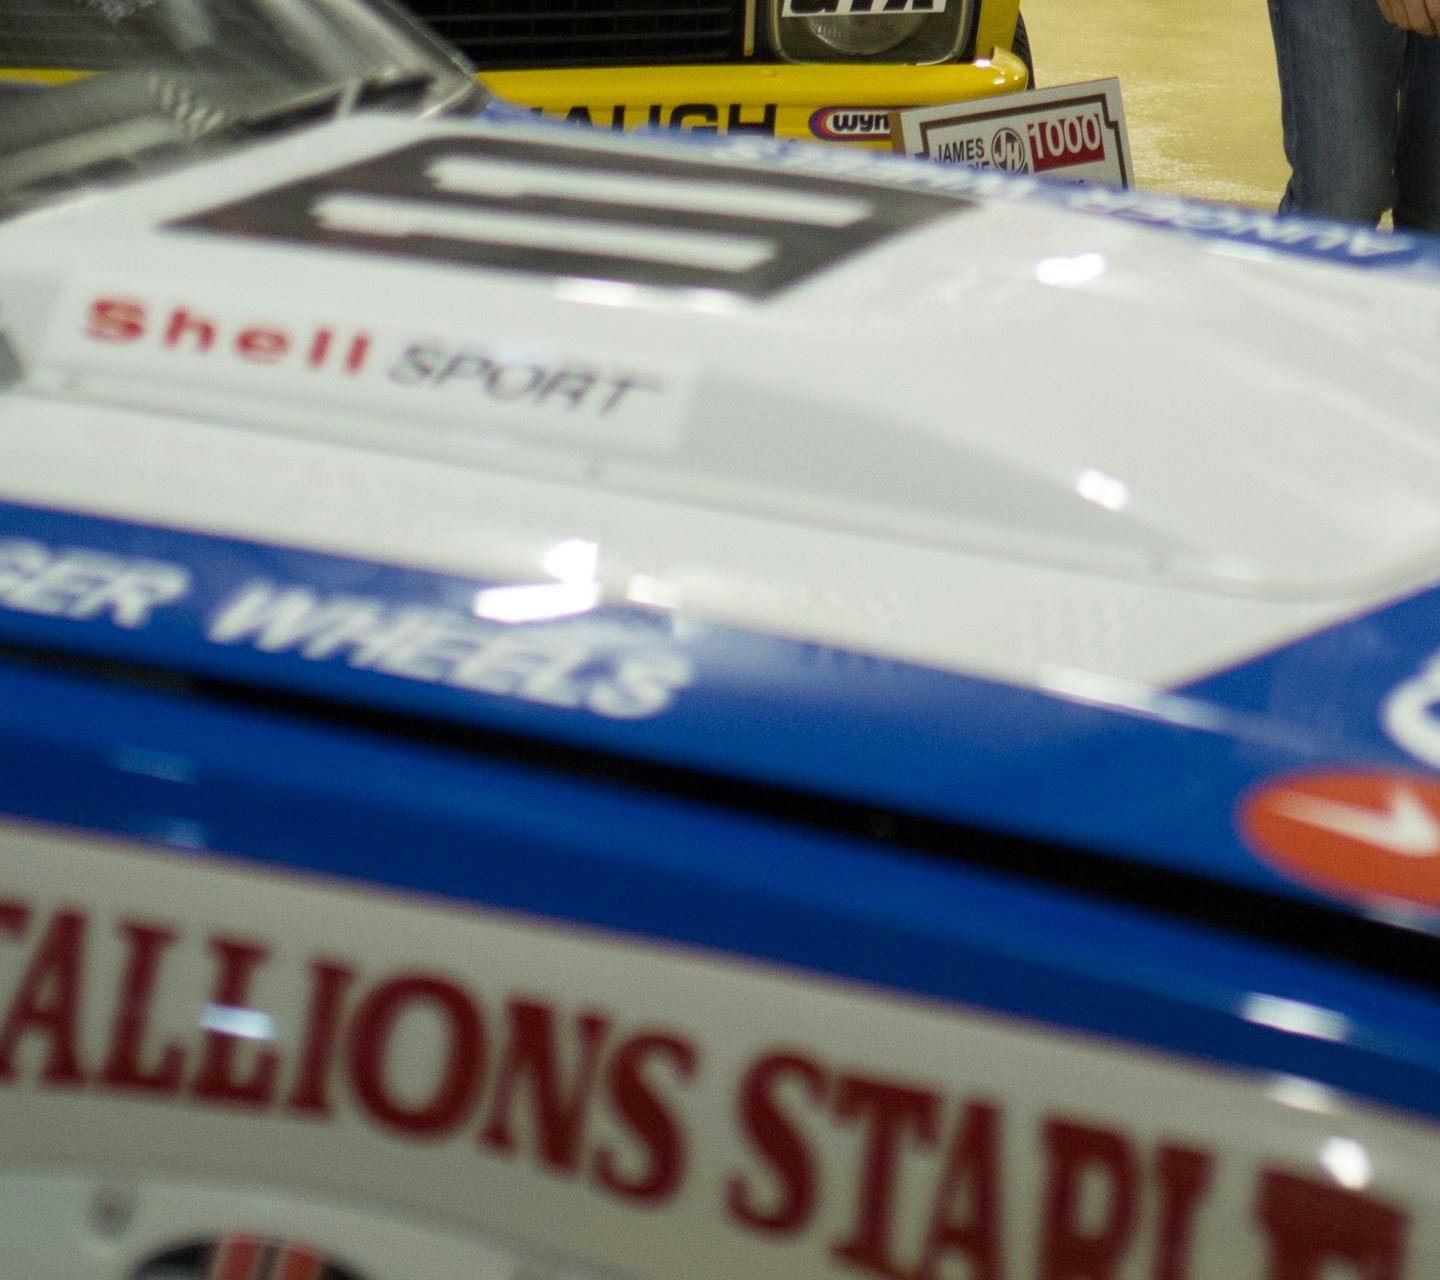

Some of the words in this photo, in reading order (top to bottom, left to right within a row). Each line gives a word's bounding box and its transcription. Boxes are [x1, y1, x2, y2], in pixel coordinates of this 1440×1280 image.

[832, 111, 891, 135] wyn
[1028, 112, 1104, 160] 1000
[935, 137, 986, 165] JAMES
[82, 292, 370, 377] Shell
[386, 342, 664, 418] SPORT
[208, 581, 695, 721] WHEELS
